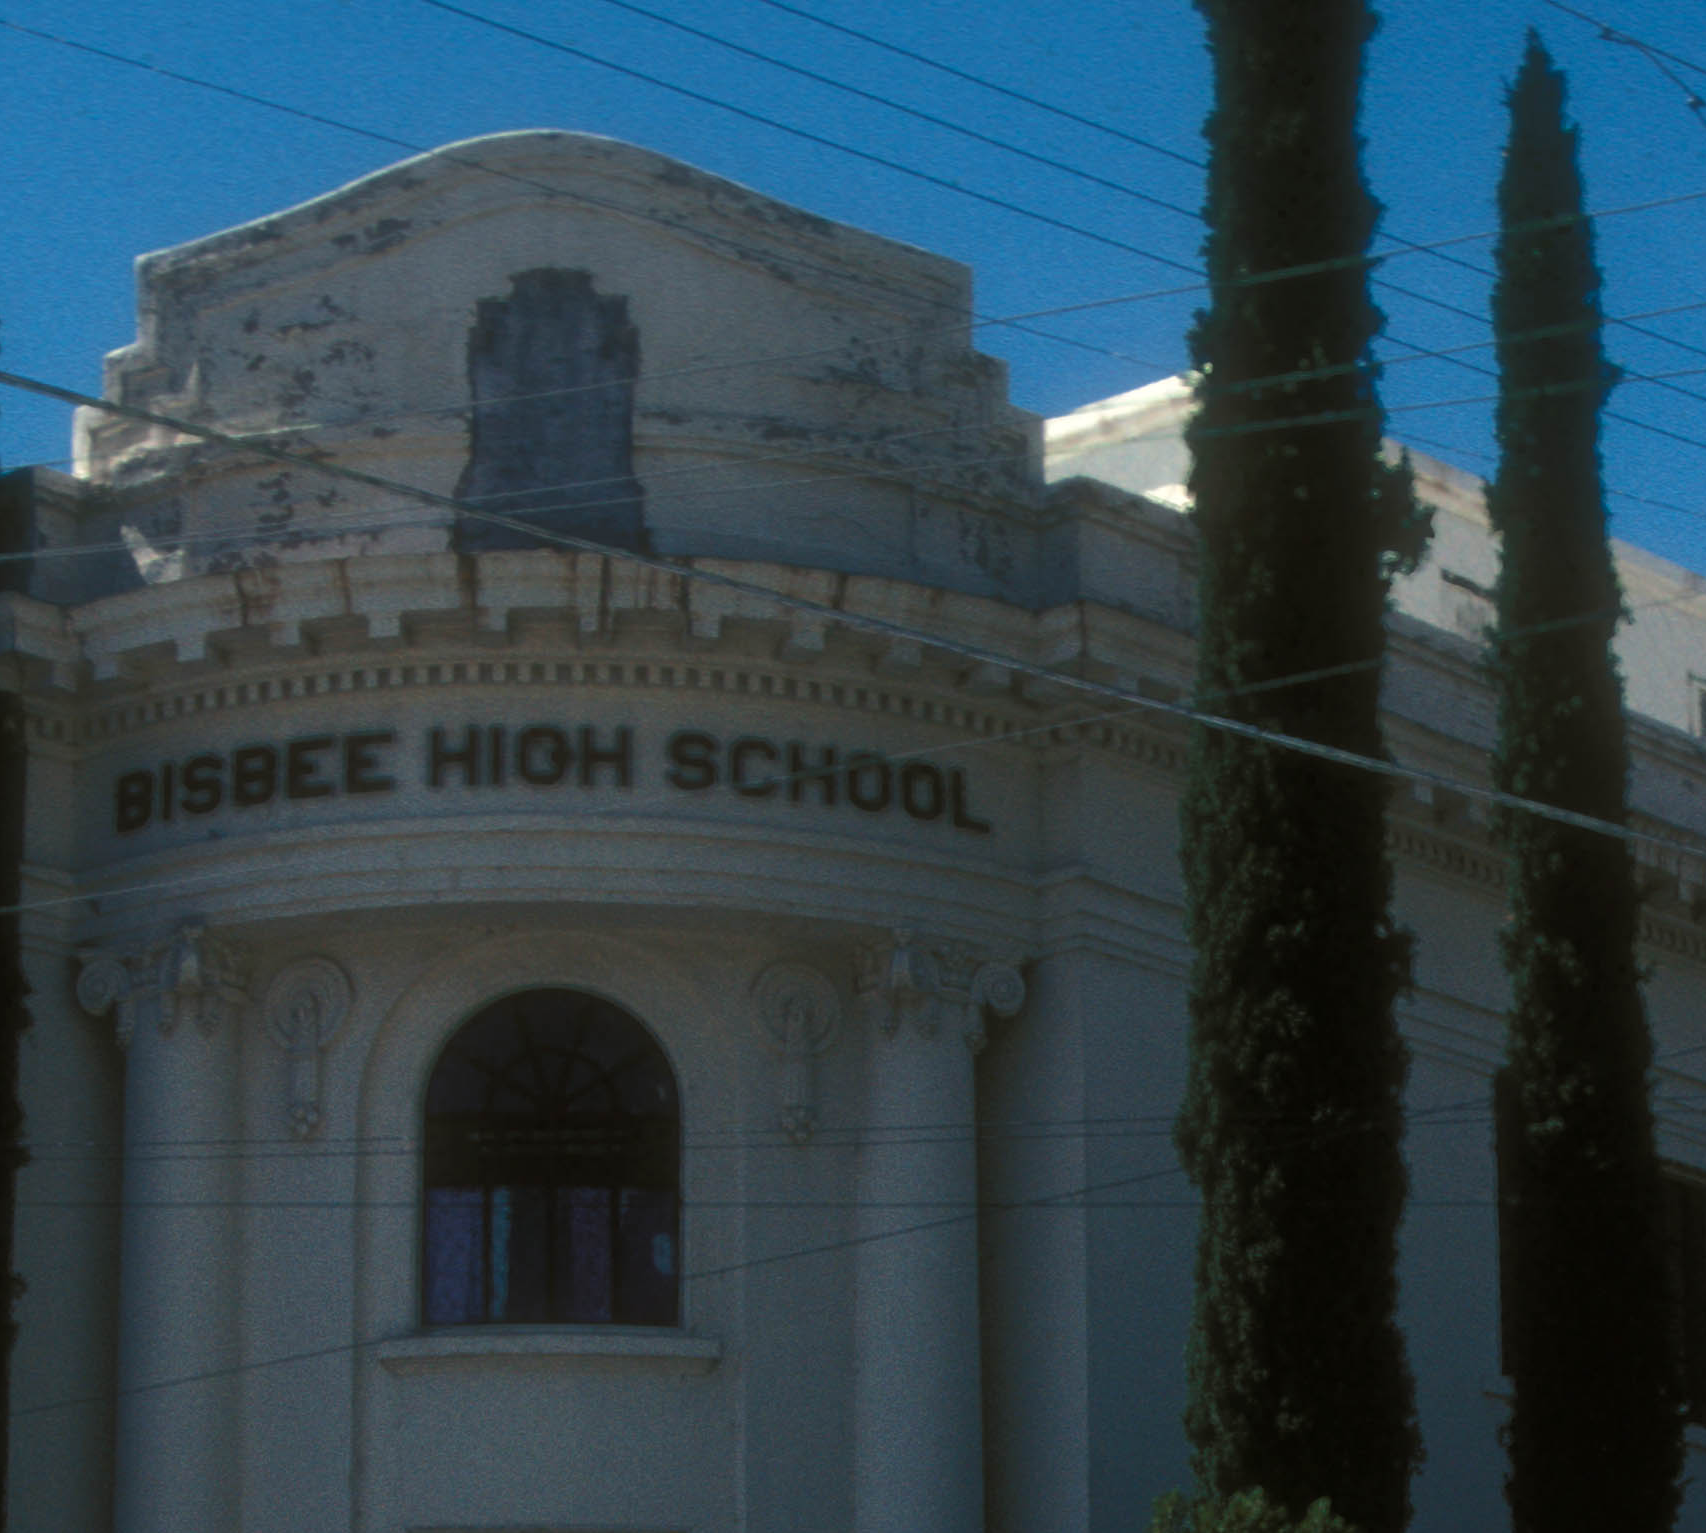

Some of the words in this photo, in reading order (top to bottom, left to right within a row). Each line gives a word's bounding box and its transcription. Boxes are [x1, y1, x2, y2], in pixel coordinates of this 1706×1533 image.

[115, 728, 398, 834] BISBEE
[428, 725, 633, 790] HIGH
[664, 727, 991, 834] SCHOOL
